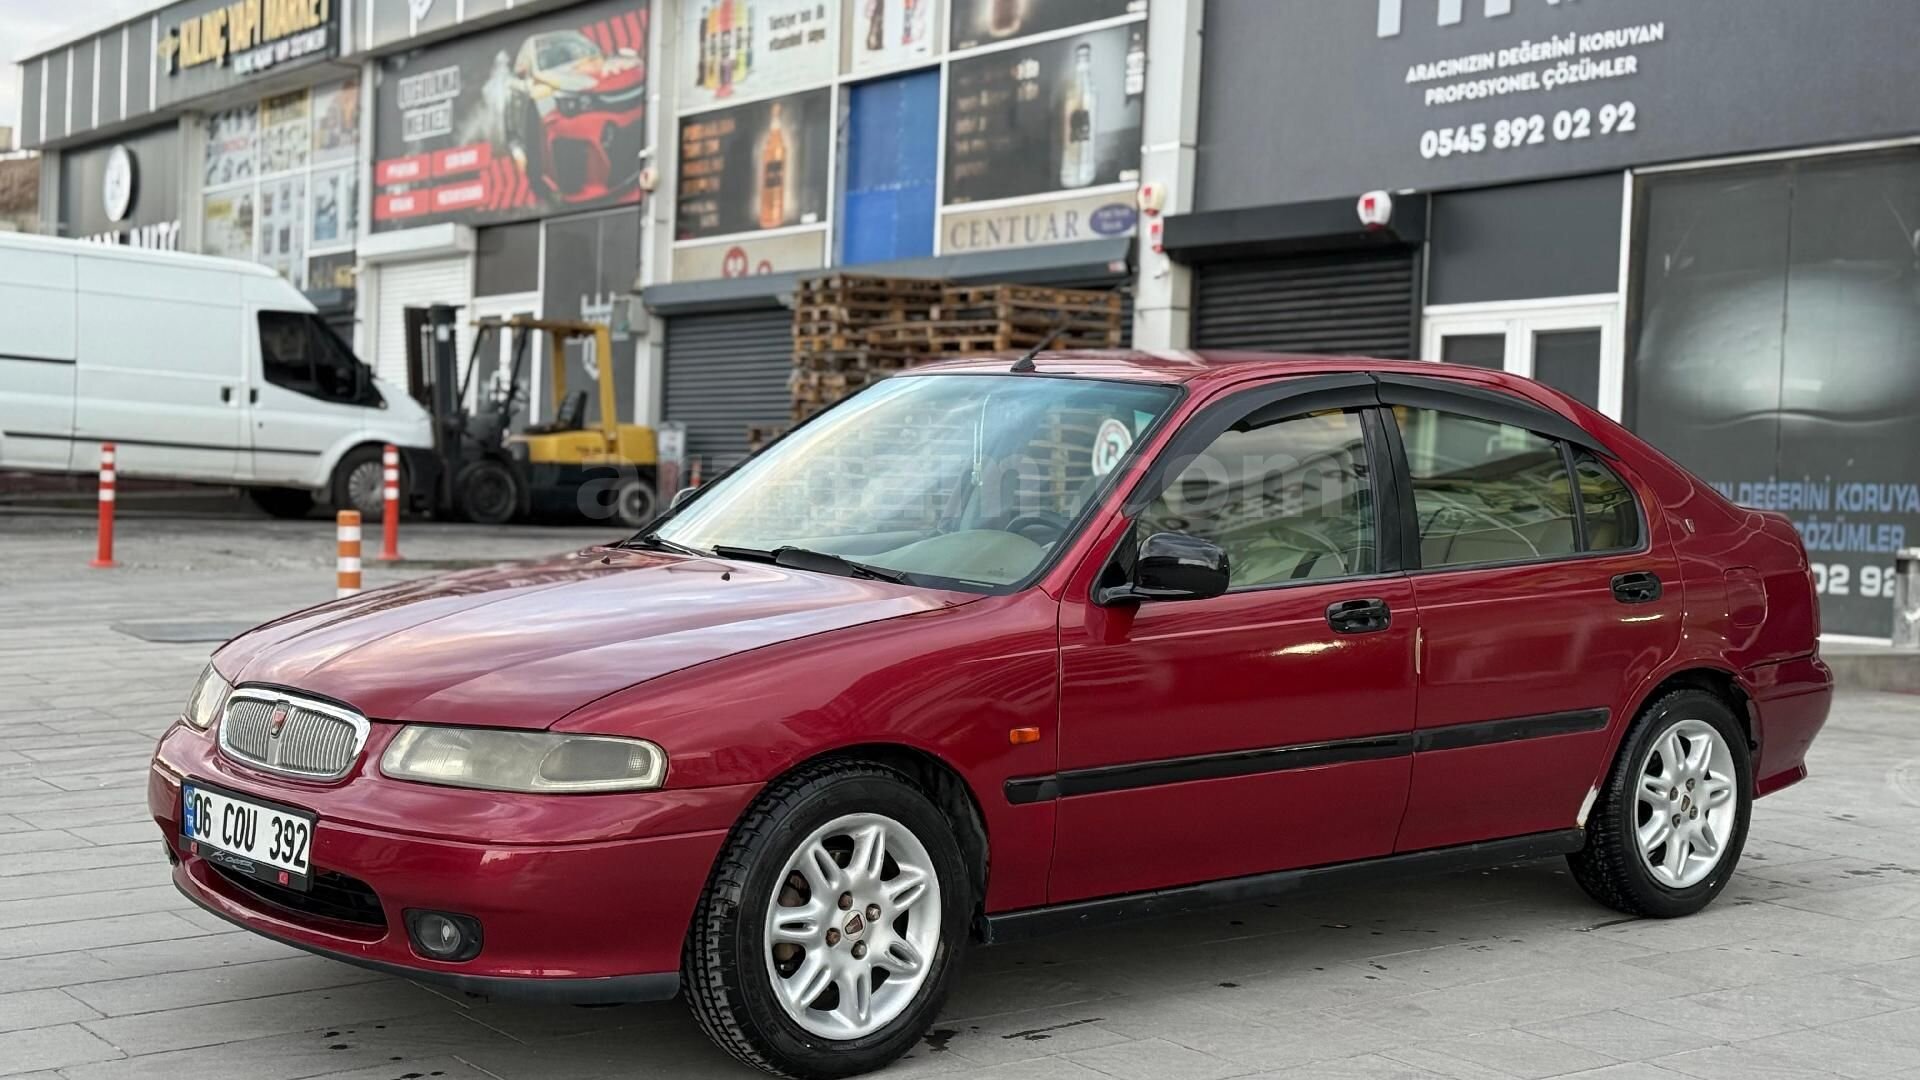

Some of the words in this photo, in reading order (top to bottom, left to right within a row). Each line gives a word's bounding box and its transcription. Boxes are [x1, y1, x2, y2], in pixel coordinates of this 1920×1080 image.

[1405, 52, 1495, 83] ARACINIZIN
[1498, 32, 1576, 67] DEĞERİNİ
[1579, 22, 1664, 53] KORUYAN
[1425, 71, 1540, 106] PROFOSYONEL
[1542, 55, 1637, 91] ÇÖZÜMLER
[1419, 122, 1487, 159] 0545
[1492, 113, 1545, 149] 892
[1552, 107, 1591, 140] 02
[1599, 100, 1636, 134] 92
[949, 210, 1079, 250] CENTUAR
[1835, 482, 1920, 512] KORUYA
[194, 793, 212, 839] 06
[222, 802, 258, 853] COU
[269, 815, 308, 869] 392
